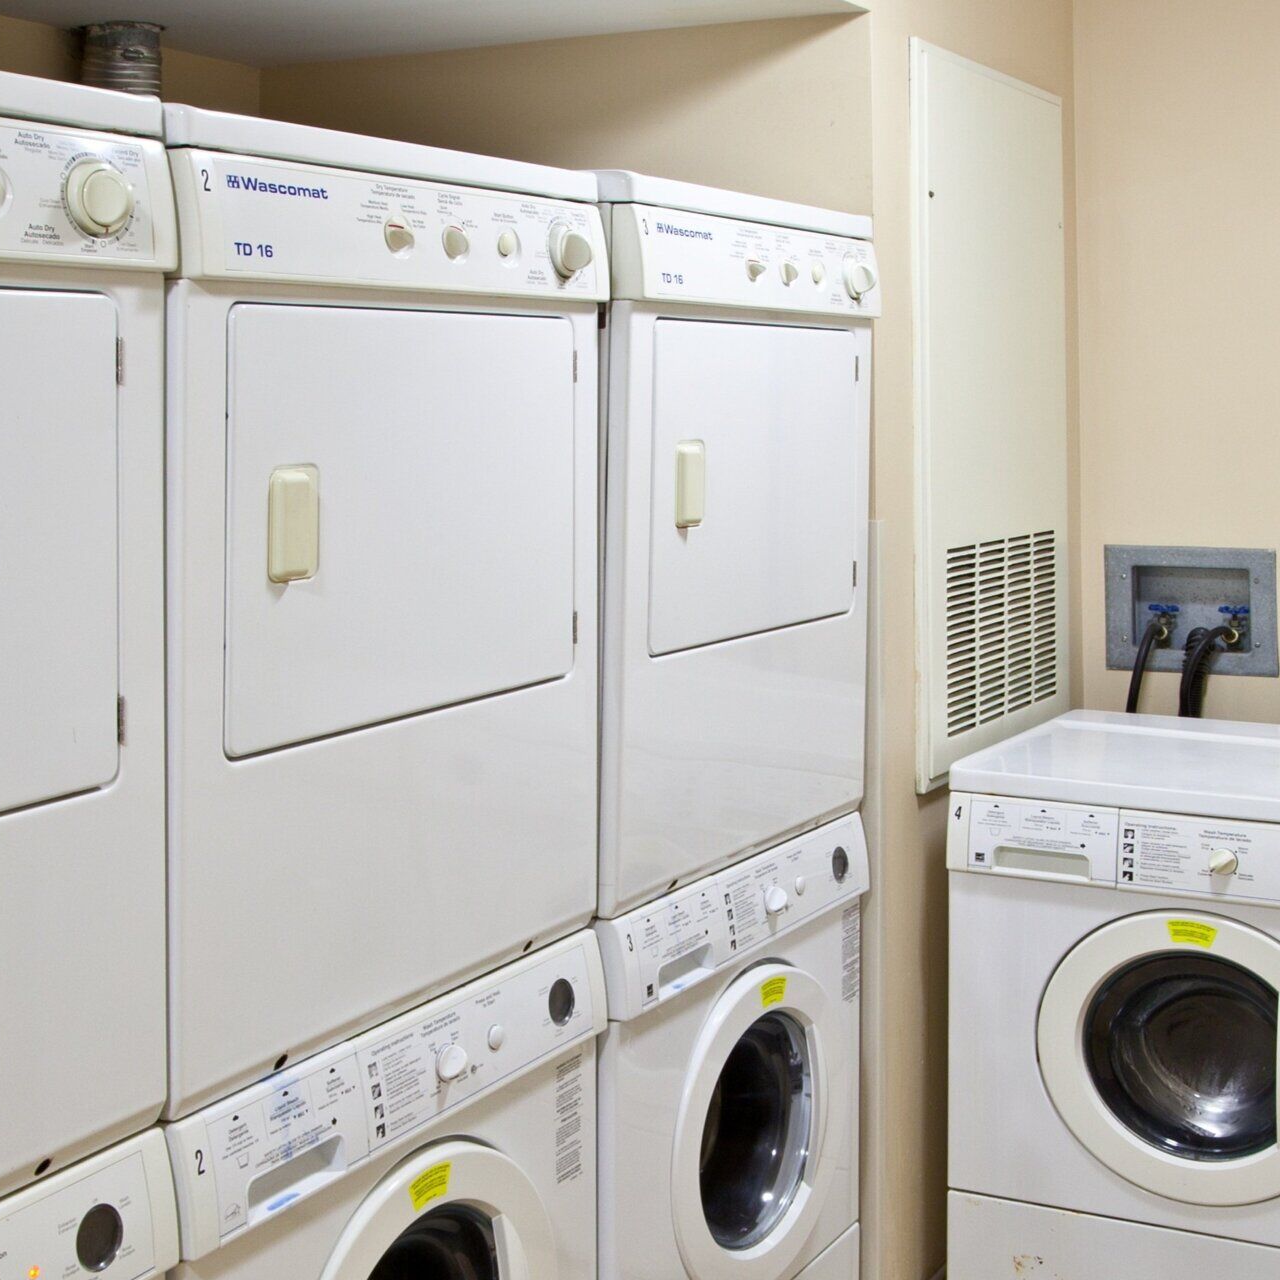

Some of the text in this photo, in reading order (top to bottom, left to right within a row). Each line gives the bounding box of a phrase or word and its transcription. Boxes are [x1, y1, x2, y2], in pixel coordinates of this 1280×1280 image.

[34, 134, 44, 142] Dry
[201, 169, 211, 192] 2
[241, 176, 328, 199] Wascomat
[664, 224, 713, 240] Wascomat
[234, 242, 273, 258] TD 16
[662, 273, 683, 284] TD 16
[955, 806, 962, 820] 4
[627, 934, 633, 952] 3
[195, 1149, 205, 1176] 2
